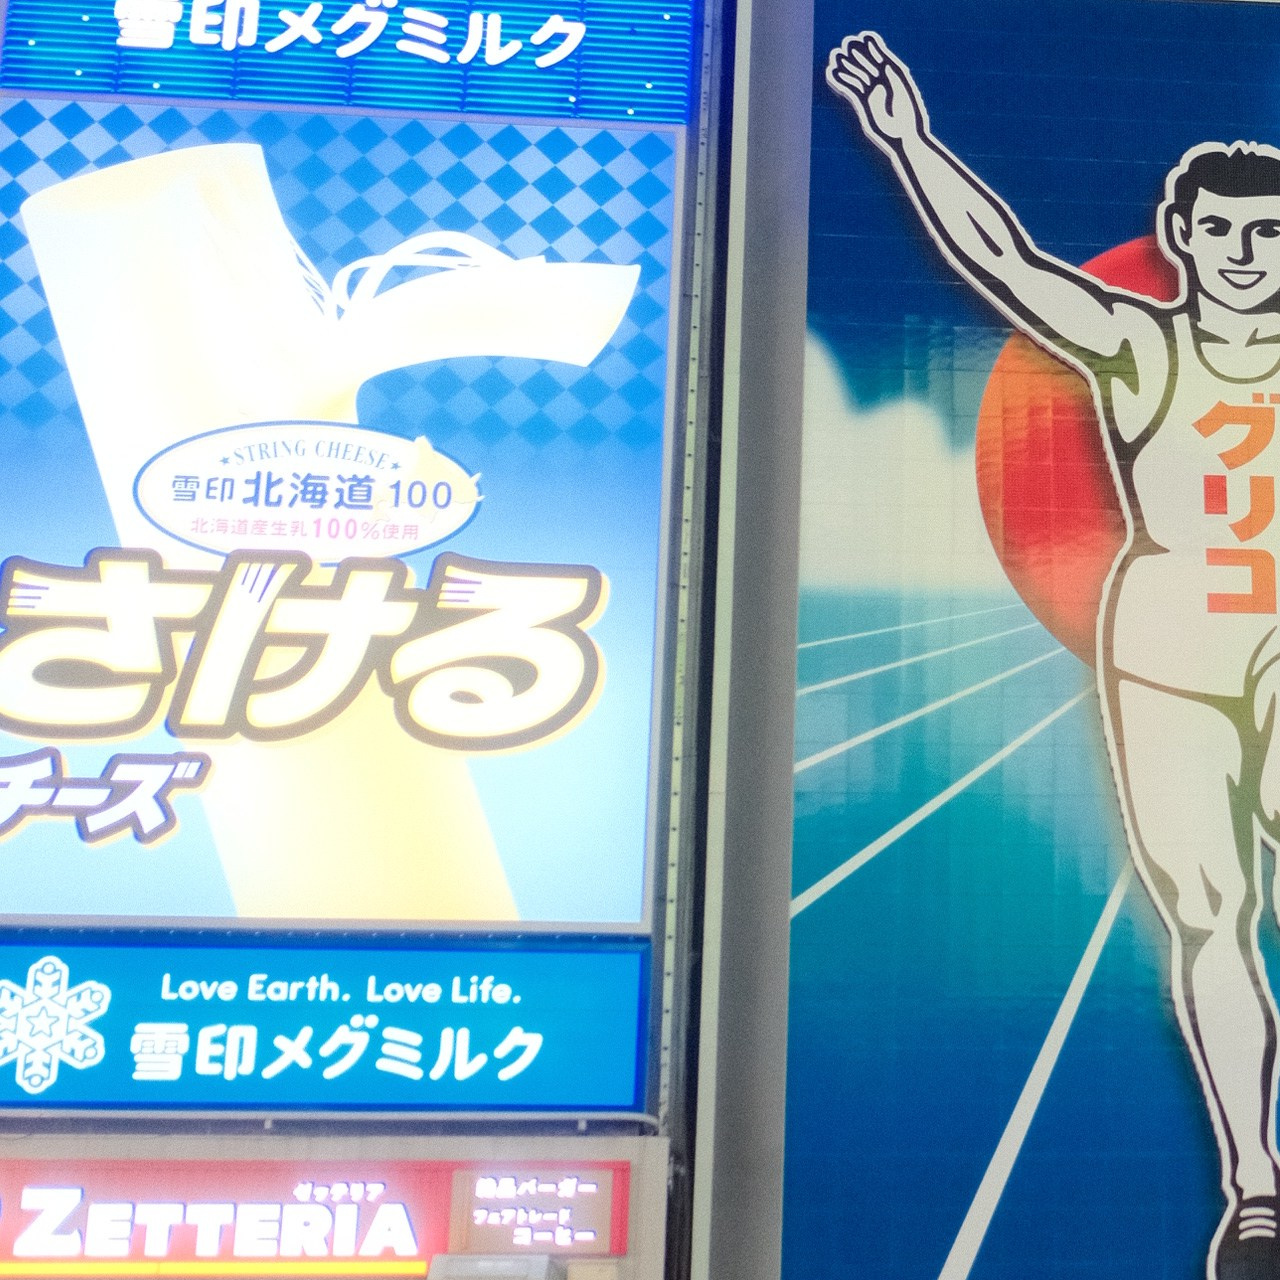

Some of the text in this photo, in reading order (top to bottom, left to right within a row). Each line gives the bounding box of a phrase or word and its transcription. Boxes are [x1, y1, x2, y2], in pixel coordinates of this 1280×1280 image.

[233, 439, 387, 470] STRING CHEESE
[0, 548, 602, 748] さける
[161, 973, 521, 1005] Love Earth. Love Life.
[130, 1013, 543, 1082] 雪印メグミルク
[13, 1185, 418, 1258] ZETTERIA
